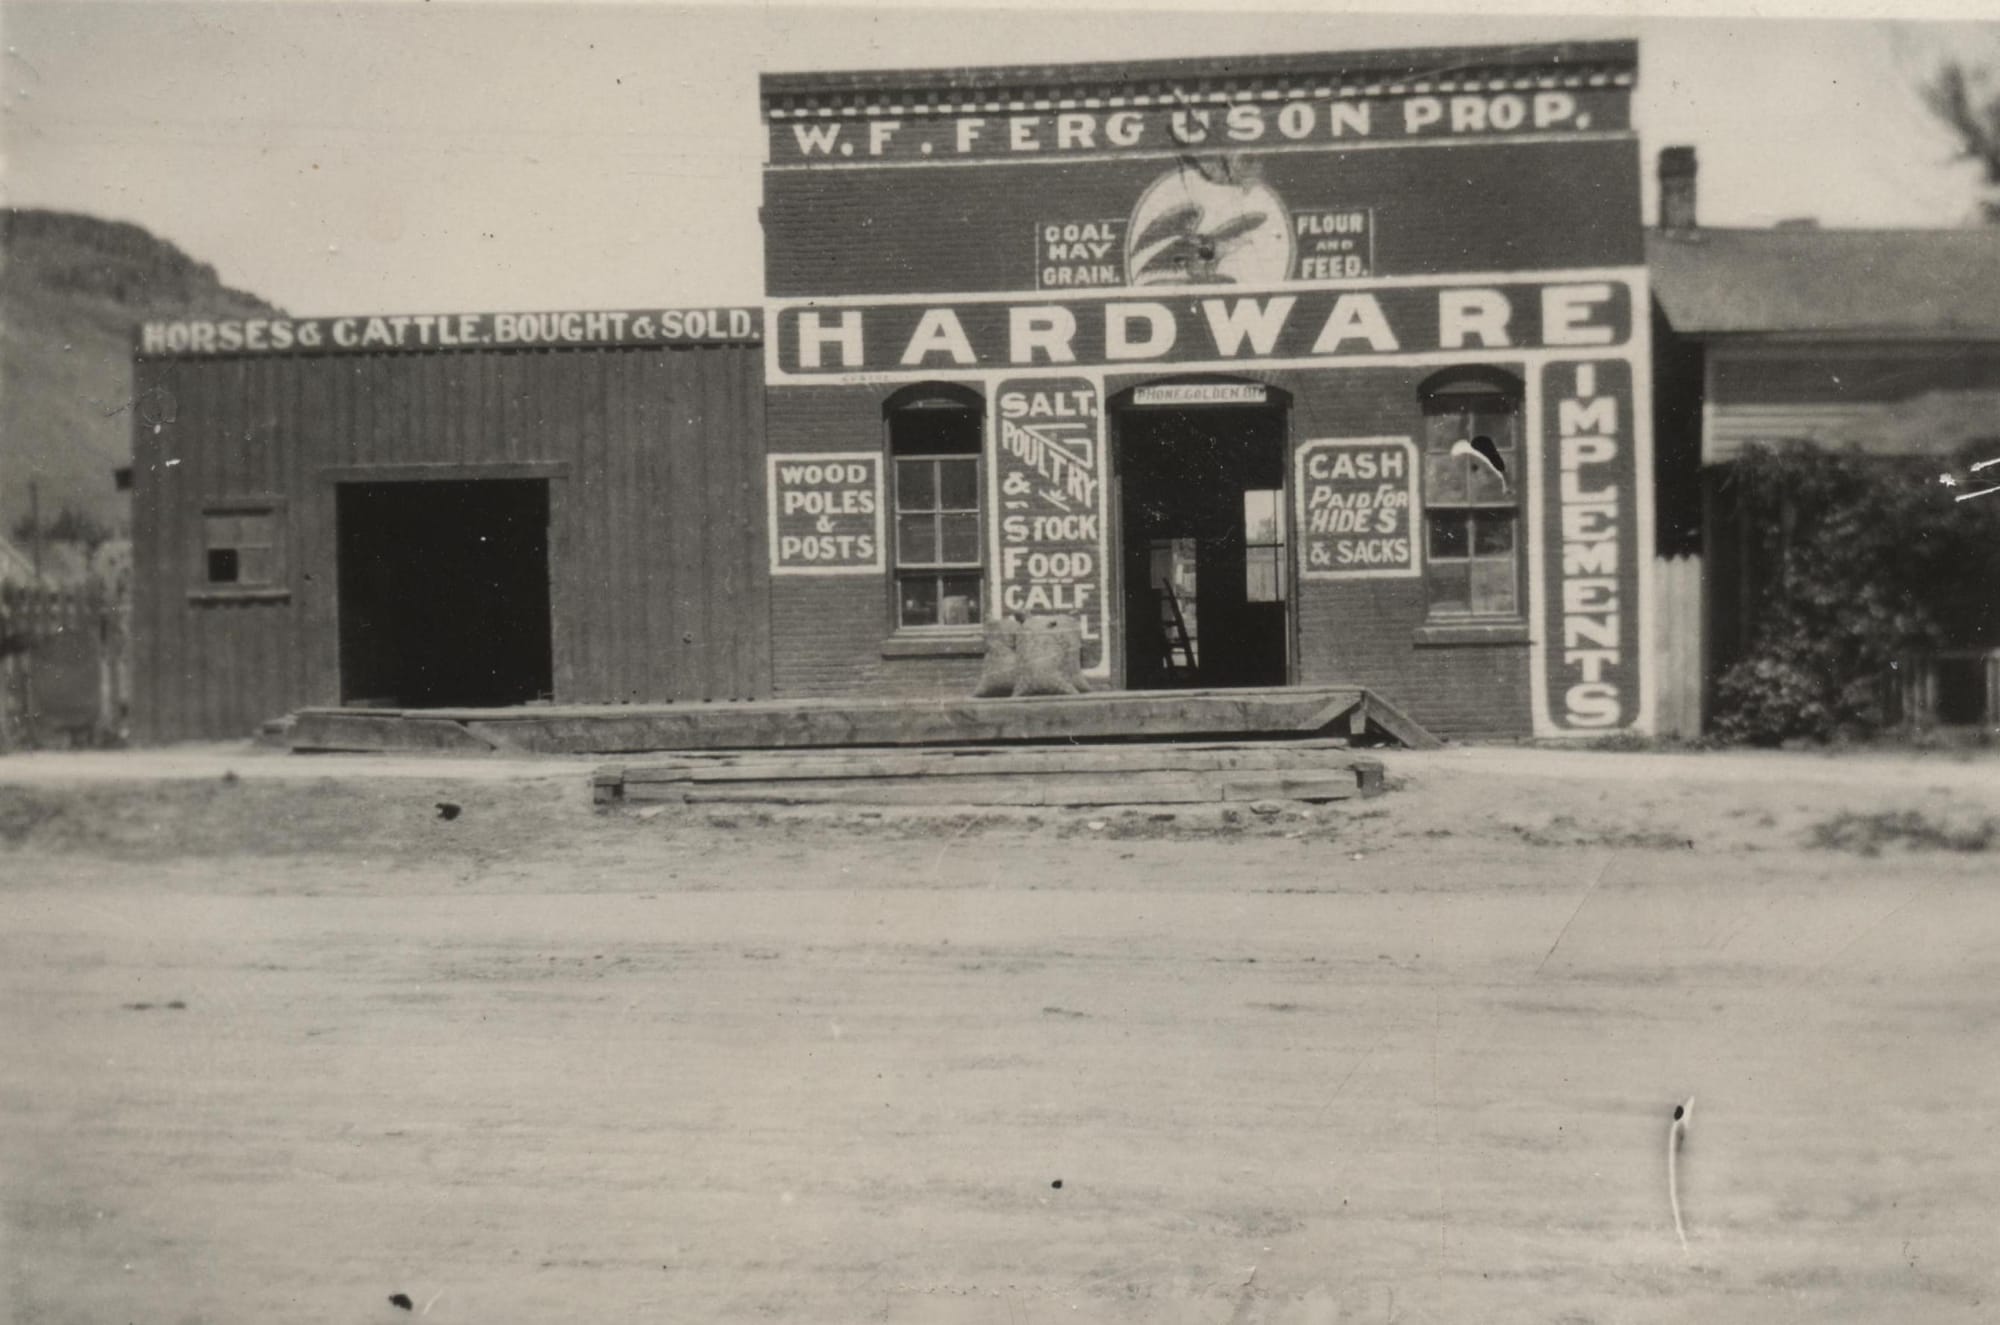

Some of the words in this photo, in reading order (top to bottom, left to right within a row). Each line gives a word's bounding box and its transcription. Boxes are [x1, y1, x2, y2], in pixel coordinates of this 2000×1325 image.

[956, 101, 1371, 154] FERGUSON
[1405, 92, 1591, 134] PROP.
[1045, 223, 1116, 243] COAL
[1297, 213, 1363, 235] FLOUR
[1049, 241, 1113, 260] HAY
[1315, 240, 1353, 251] AND
[1043, 264, 1120, 285] GRAIN.
[1302, 255, 1368, 279] FEED.
[143, 318, 293, 353] HORSES
[298, 321, 321, 346] &
[494, 311, 628, 343] BOUGHT
[631, 315, 655, 340] &
[661, 309, 760, 340] SOLD.
[801, 284, 1615, 368] HARDWARE
[1000, 390, 1097, 418] SALT.
[781, 464, 867, 485] WOOD
[1002, 419, 1097, 508] POULTRY
[1309, 451, 1403, 480] CASH
[1002, 471, 1031, 496] &
[784, 489, 875, 515] POLES
[816, 515, 837, 533] &
[1003, 514, 1098, 542] STOCK
[781, 535, 874, 561] POSTS
[1310, 541, 1331, 565] &
[1336, 538, 1409, 564] SACKS
[1558, 363, 1622, 727] IMPLEMENTS
[1004, 547, 1093, 580] FOOD
[1004, 583, 1096, 611] CALF
